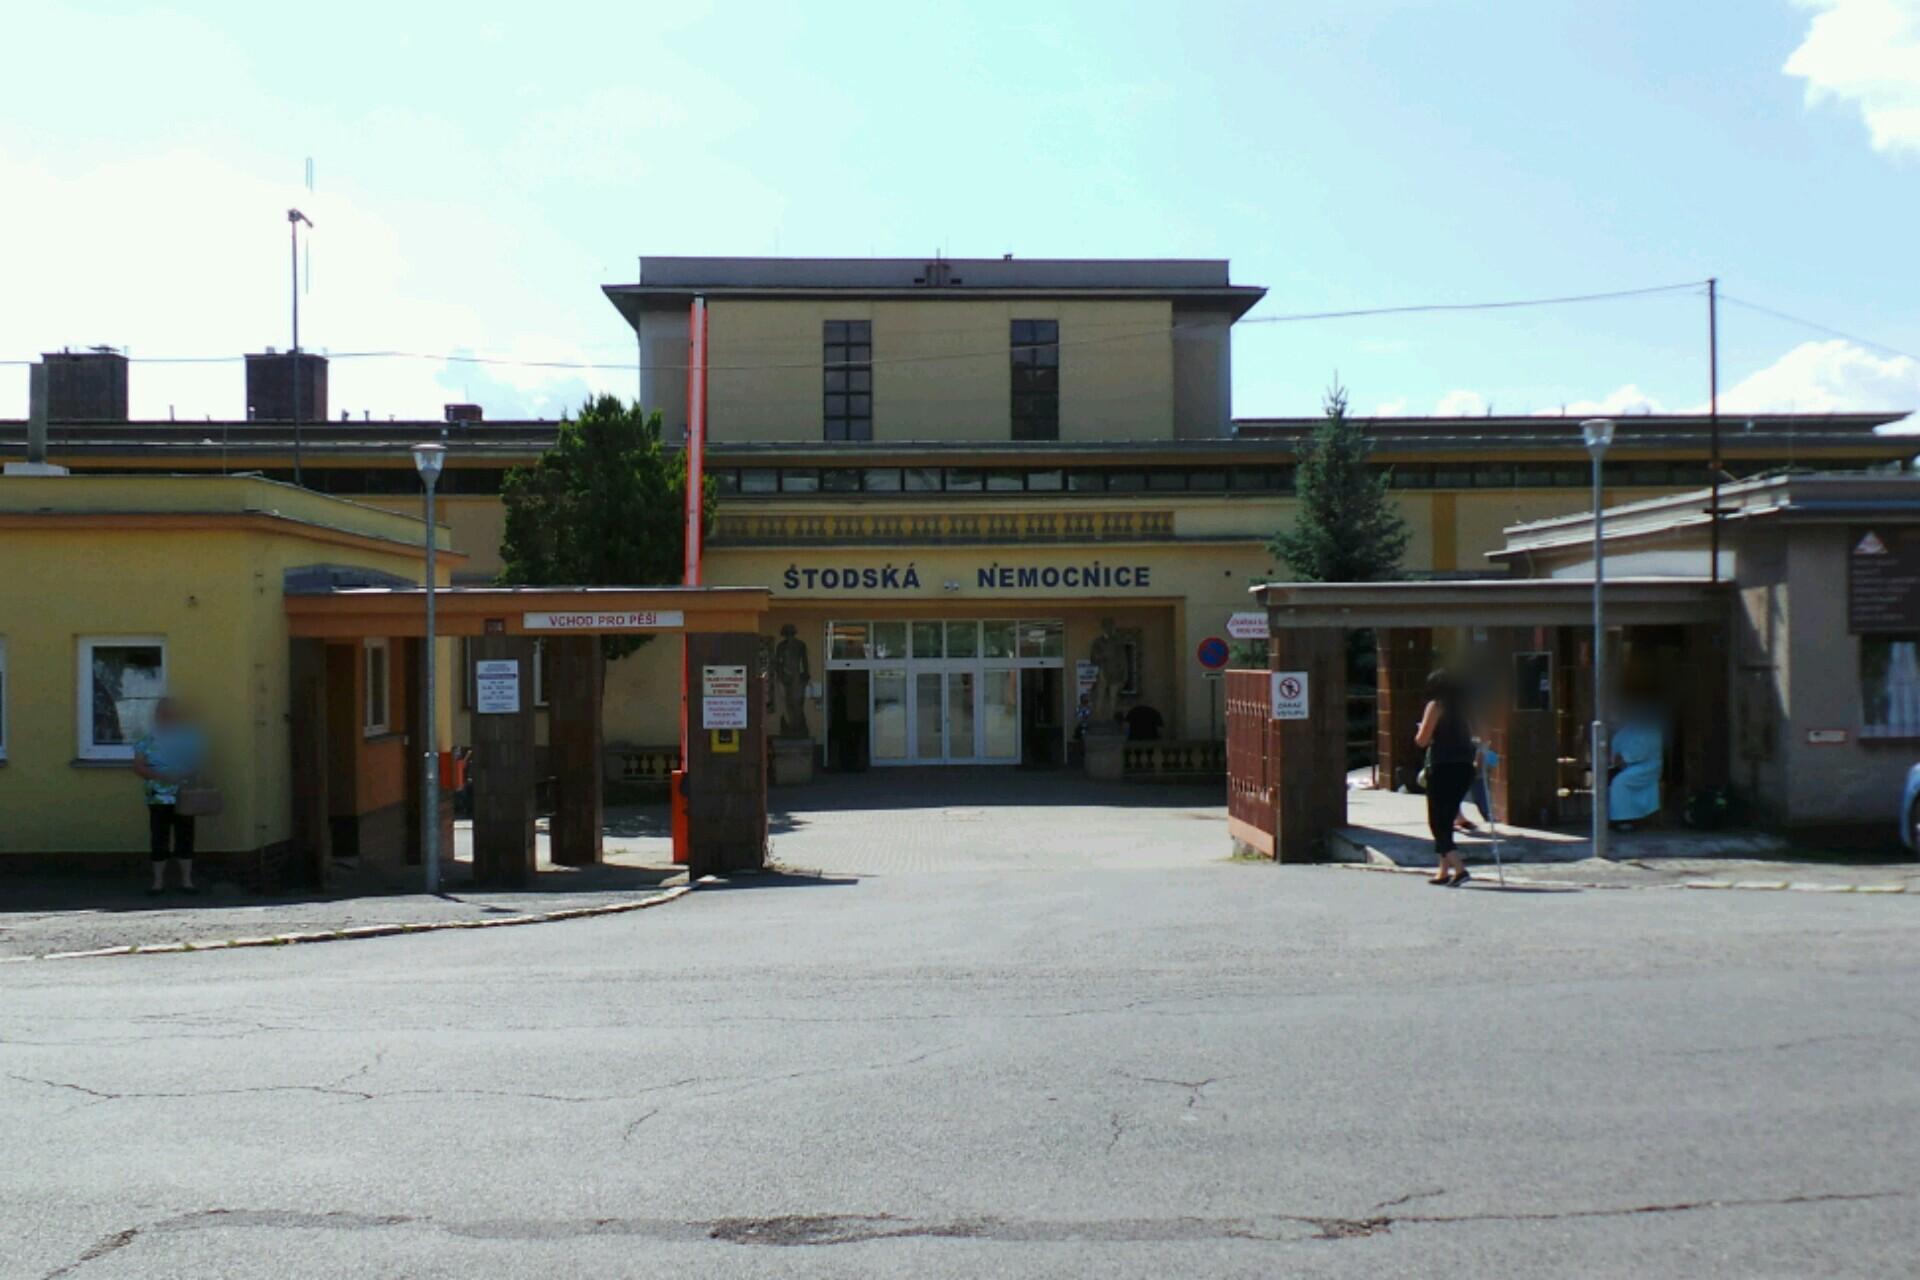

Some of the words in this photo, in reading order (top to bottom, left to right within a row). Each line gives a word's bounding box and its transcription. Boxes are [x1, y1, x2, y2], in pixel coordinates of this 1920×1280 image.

[977, 566, 1150, 588] NEMOCNICE
[548, 615, 593, 627] VCHOD
[598, 614, 625, 626] PRO
[629, 611, 656, 625] PĚŠÍ
